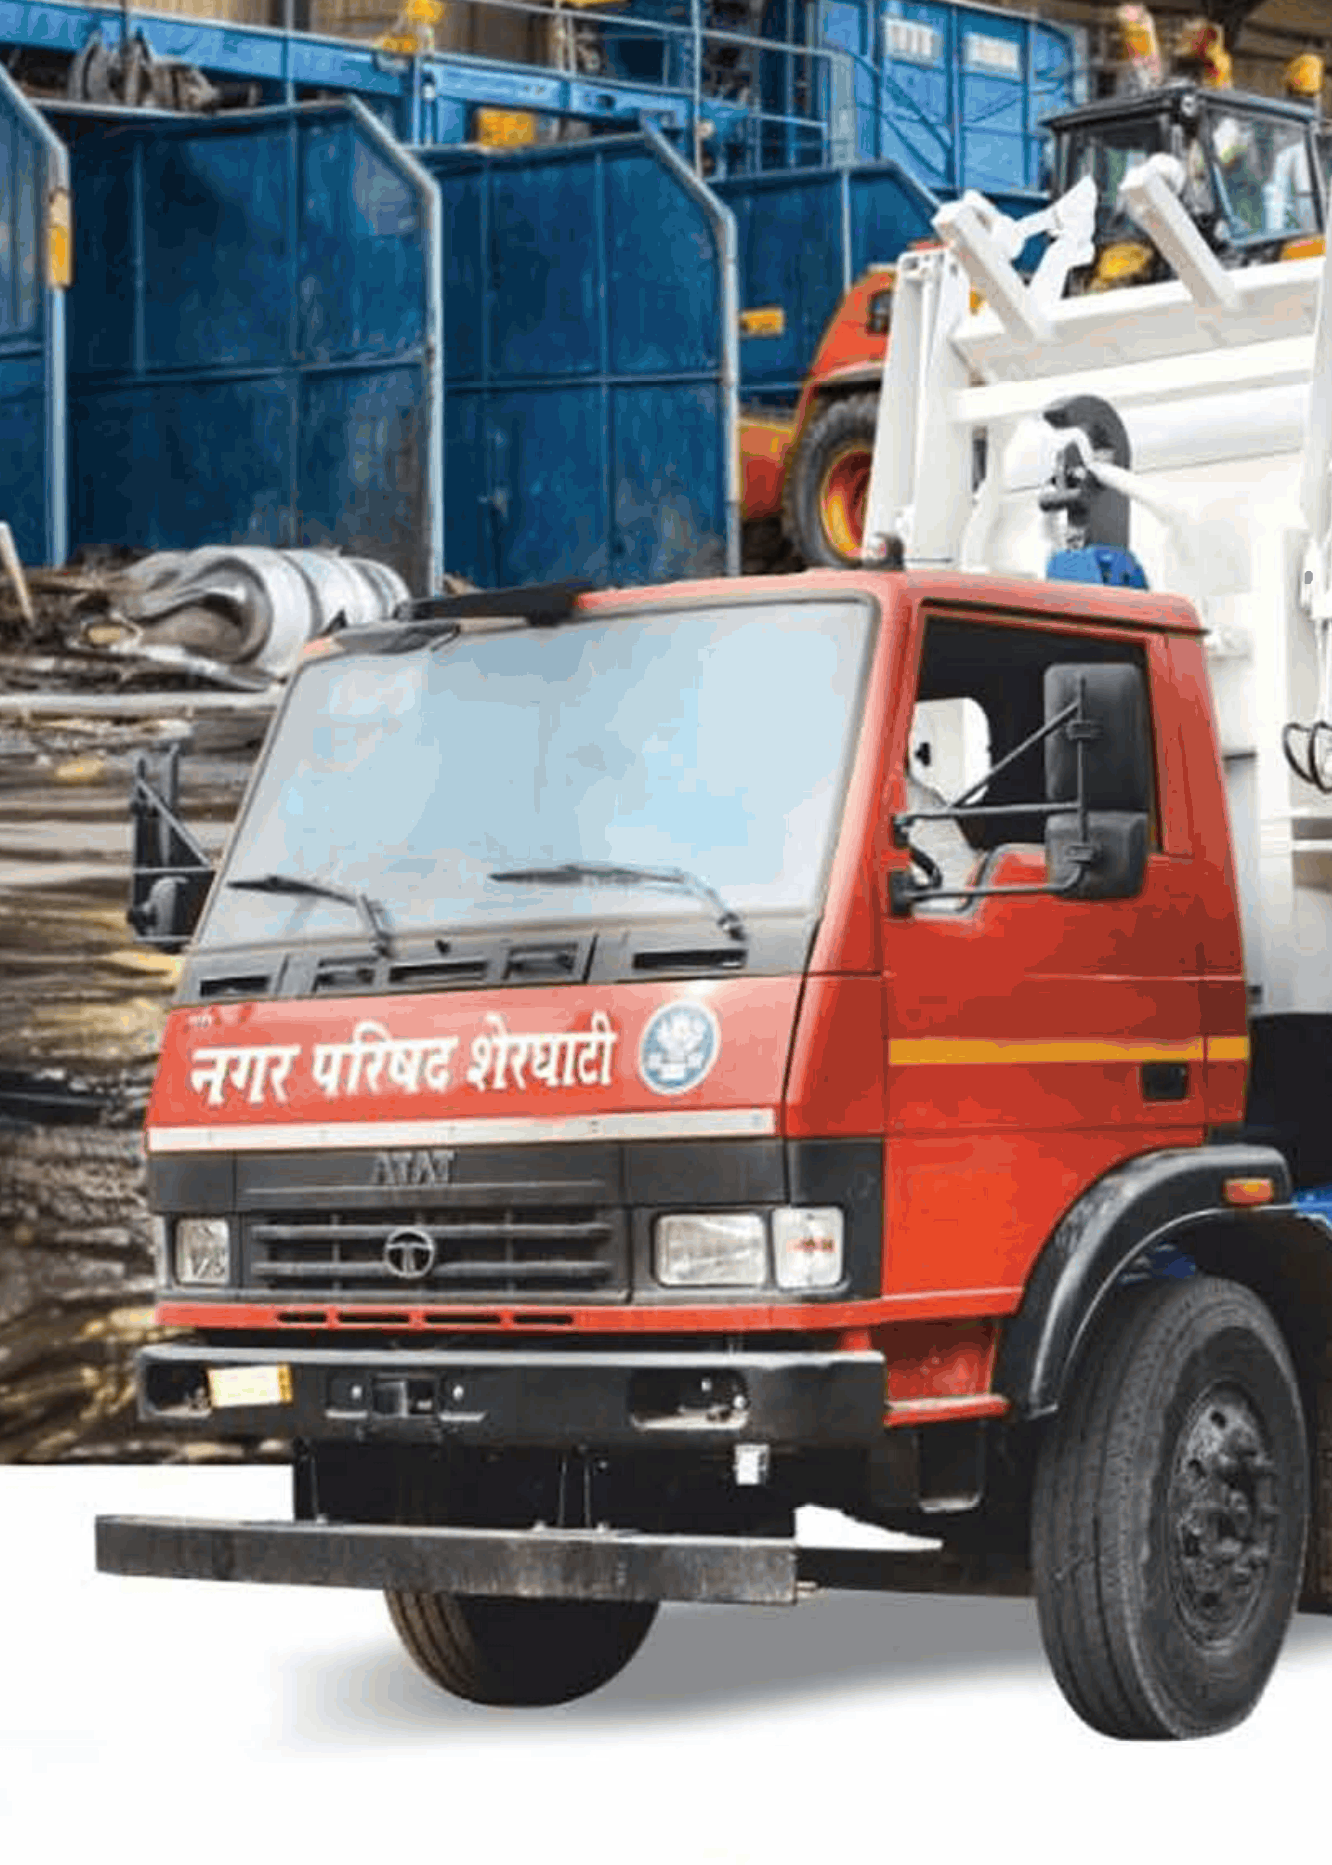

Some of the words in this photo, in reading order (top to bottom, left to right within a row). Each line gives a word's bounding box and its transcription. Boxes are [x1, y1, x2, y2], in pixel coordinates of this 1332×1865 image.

[190, 1044, 301, 1106] नगर
[312, 1020, 460, 1096] परिषद
[466, 1012, 617, 1092] शेरघाटी
